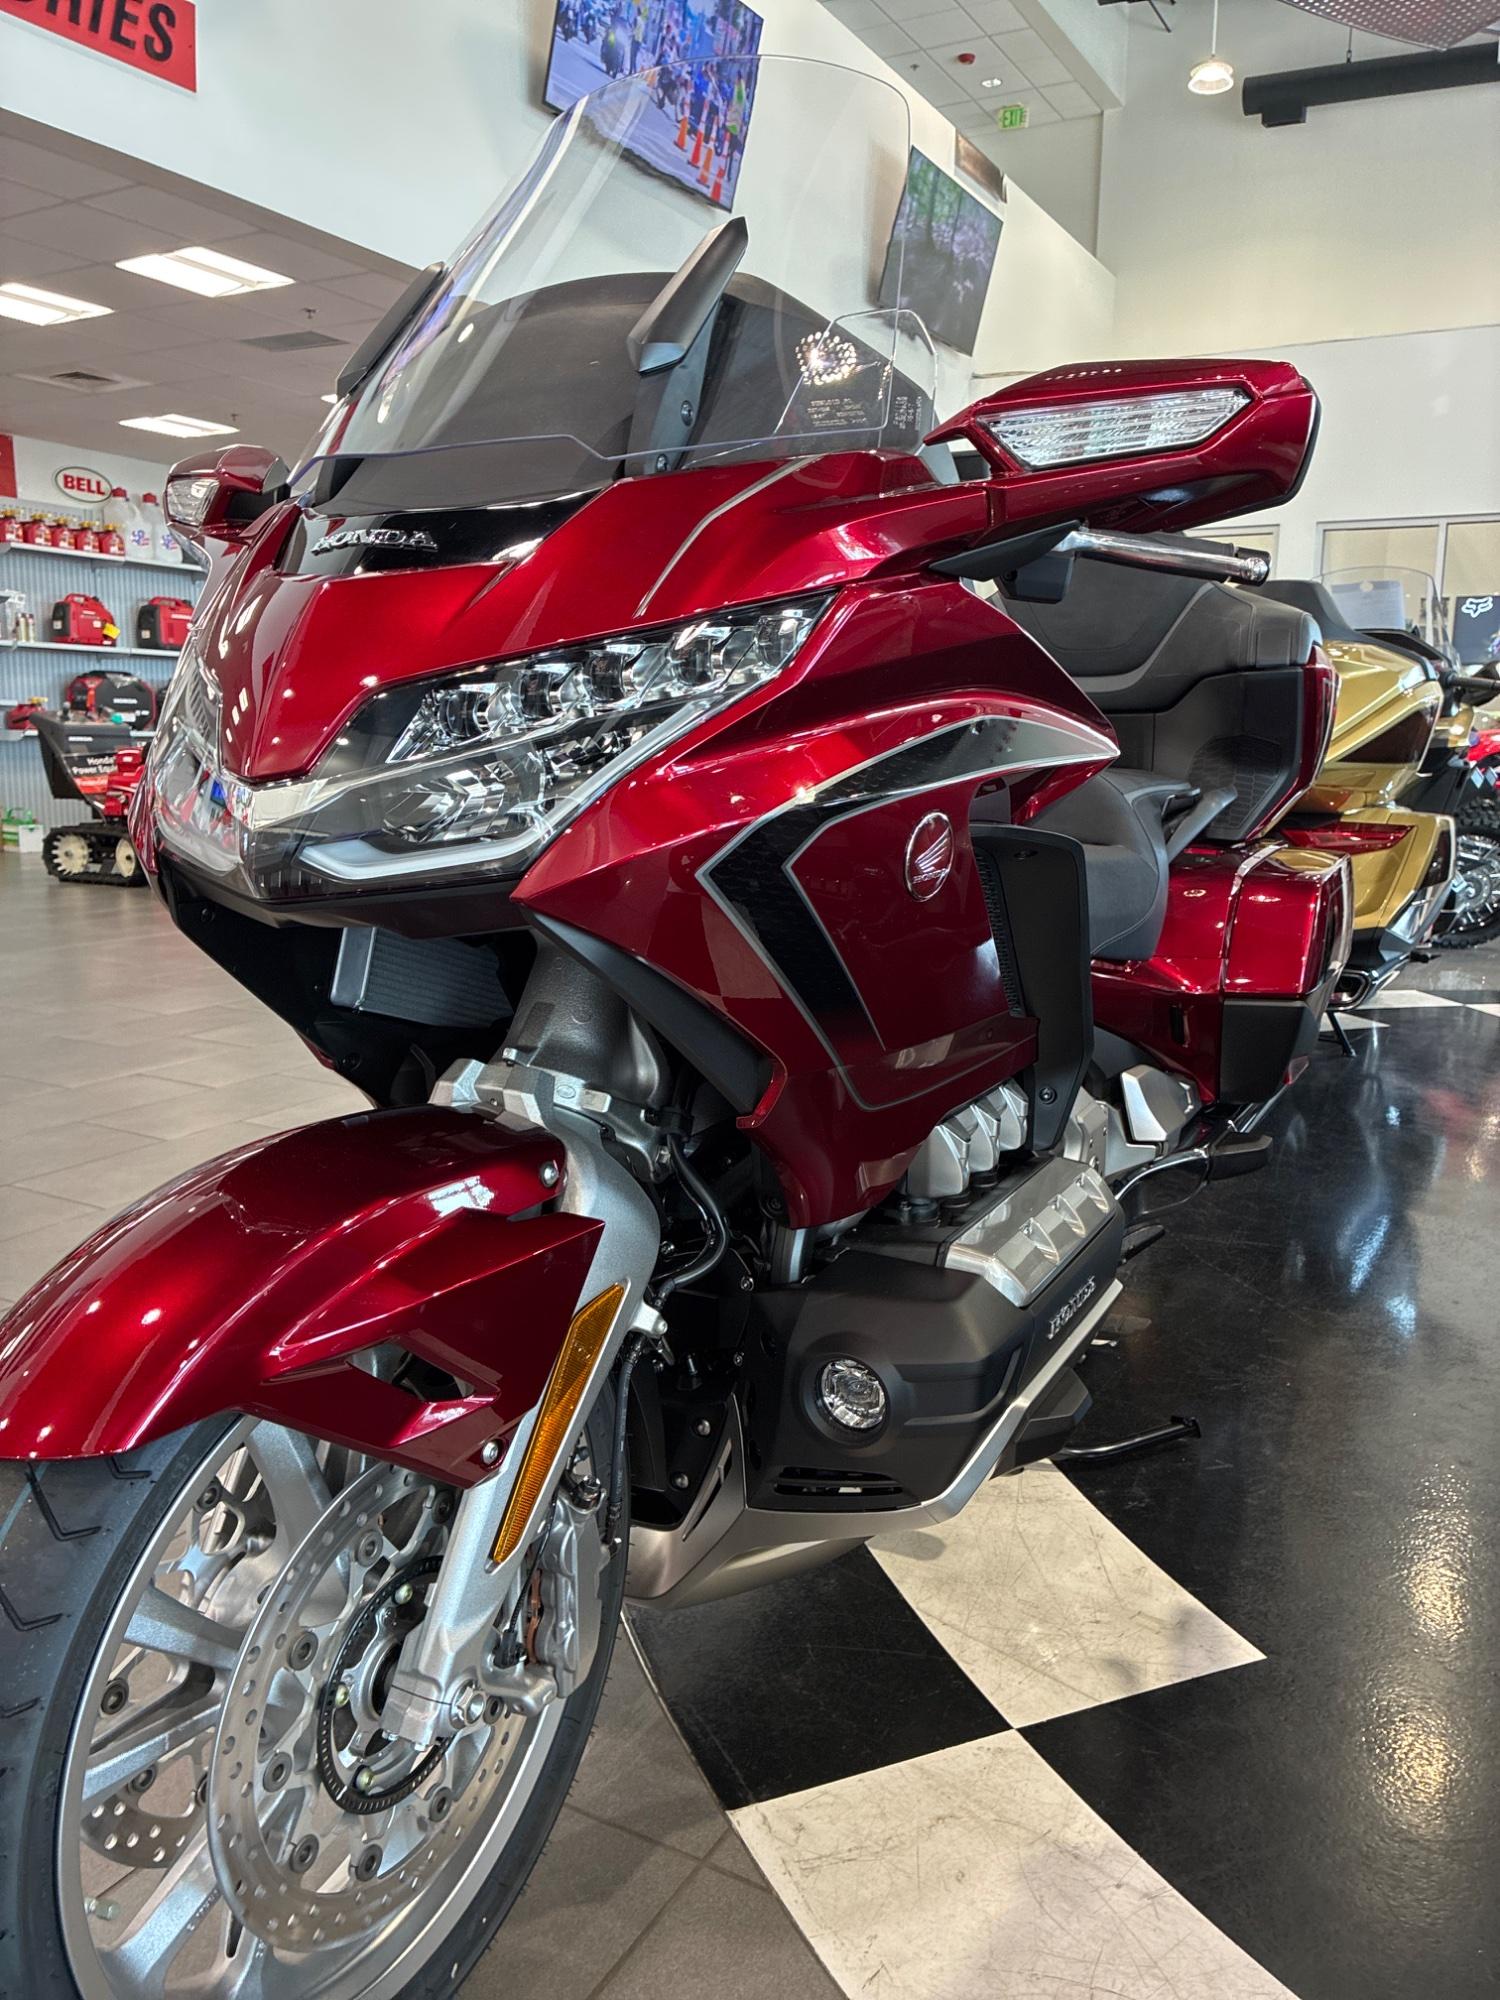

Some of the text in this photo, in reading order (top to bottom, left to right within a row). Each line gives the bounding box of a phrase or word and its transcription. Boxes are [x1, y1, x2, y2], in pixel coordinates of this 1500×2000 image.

[15, 0, 176, 62] IES
[63, 474, 105, 495] BELL
[311, 529, 438, 555] HONDA
